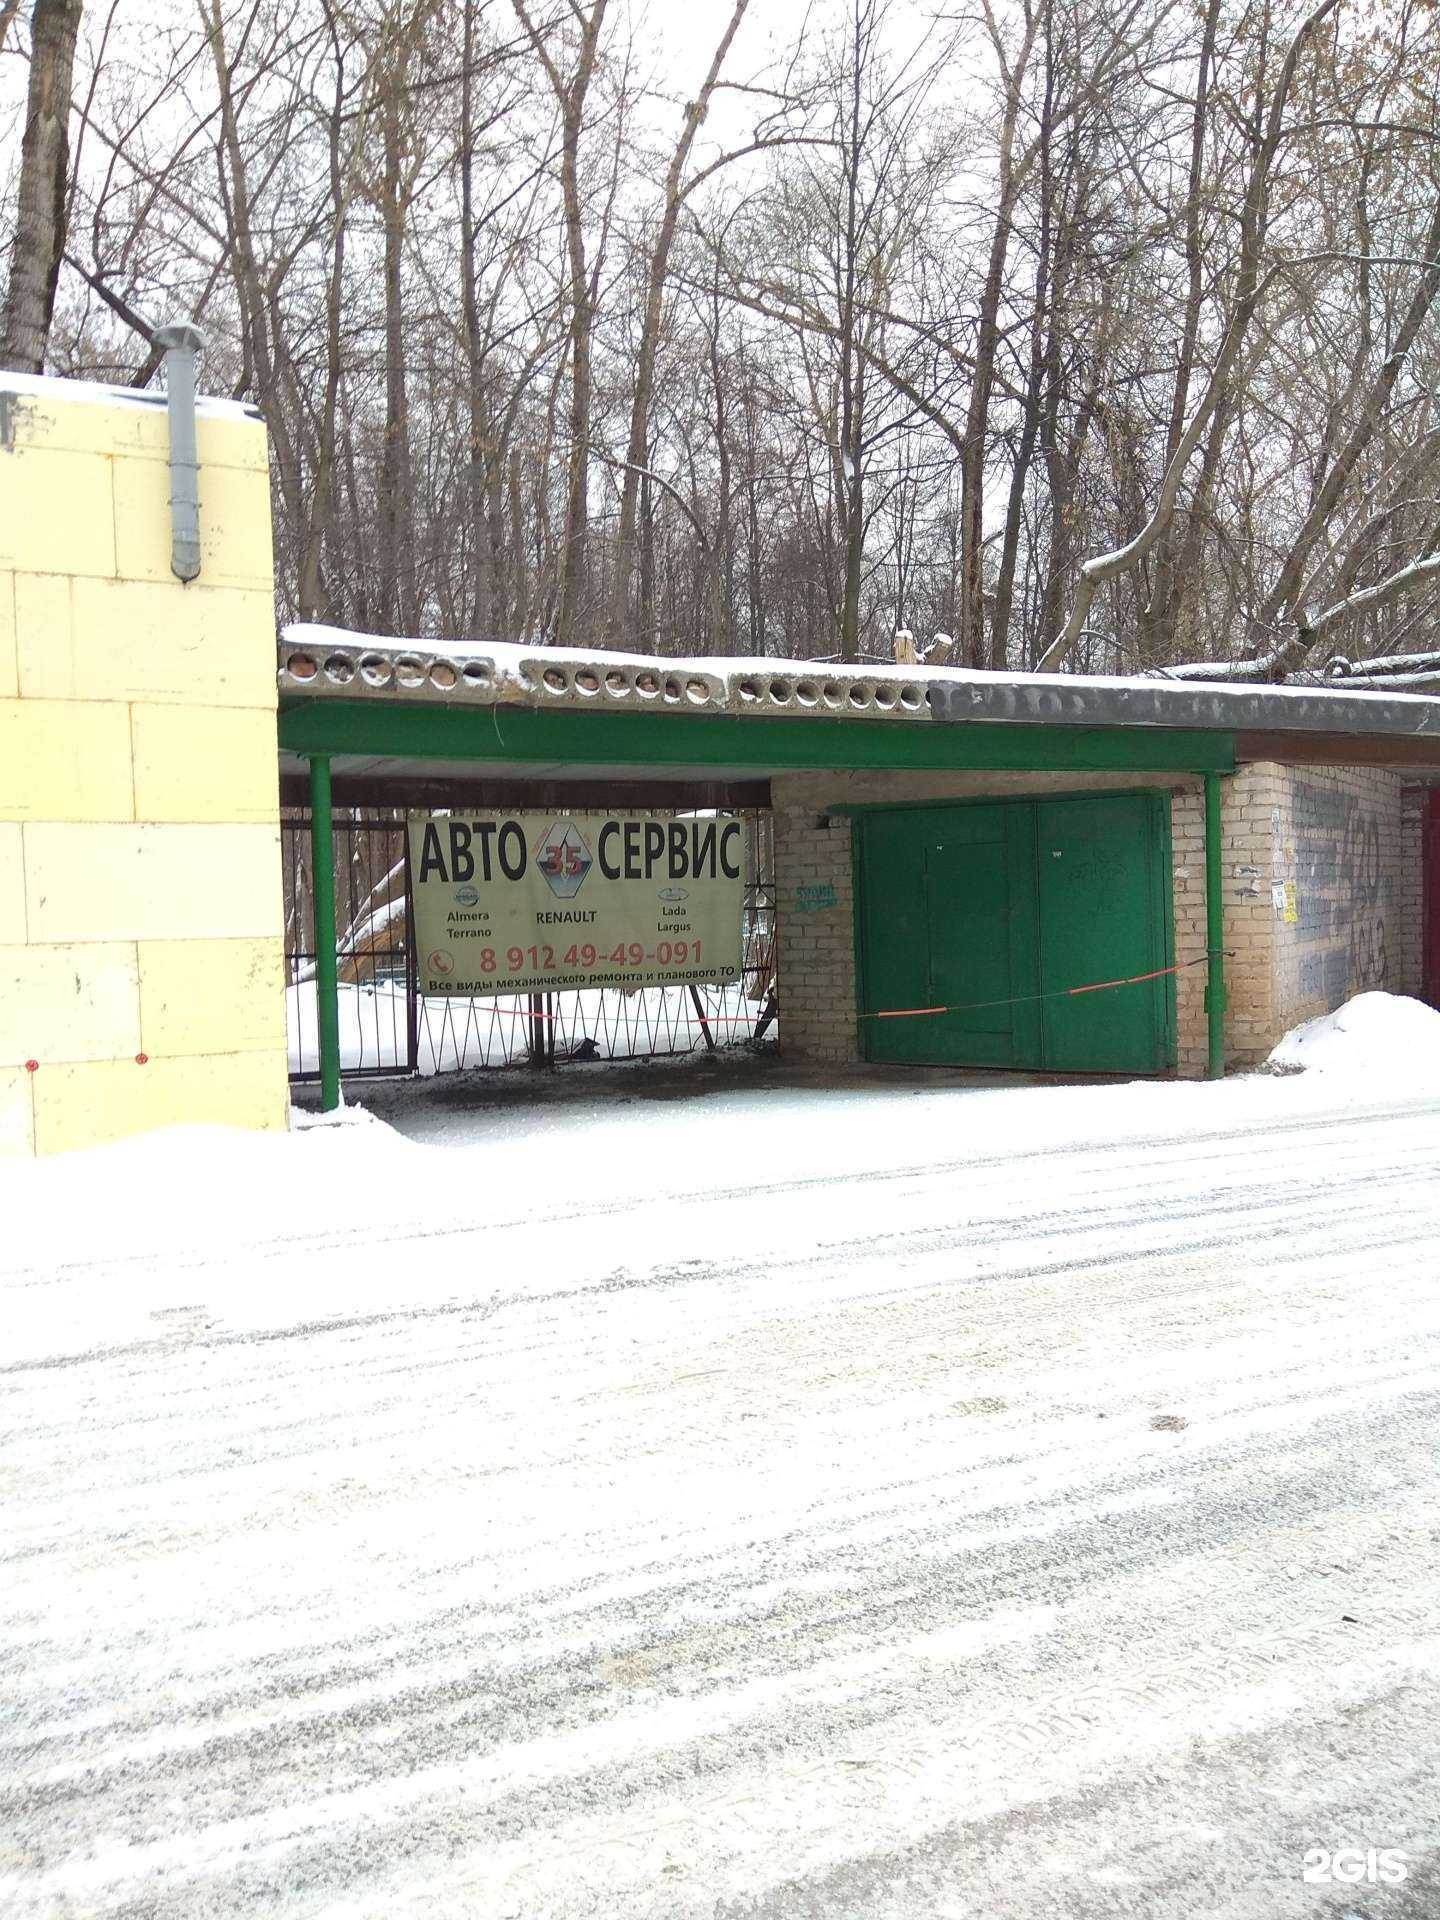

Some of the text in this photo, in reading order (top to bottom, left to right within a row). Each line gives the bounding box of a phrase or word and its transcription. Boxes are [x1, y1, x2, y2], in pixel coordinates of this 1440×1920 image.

[419, 821, 740, 883] АВТО СЕРВИС
[447, 911, 490, 922] Almera
[662, 905, 687, 916] Lada
[536, 911, 597, 925] RENAULT
[446, 928, 492, 939] Terrano
[657, 922, 692, 934] Largus
[480, 940, 703, 973] 8 912 49-49-091
[429, 966, 735, 992] Все виды механического ремонта и планового ТО
